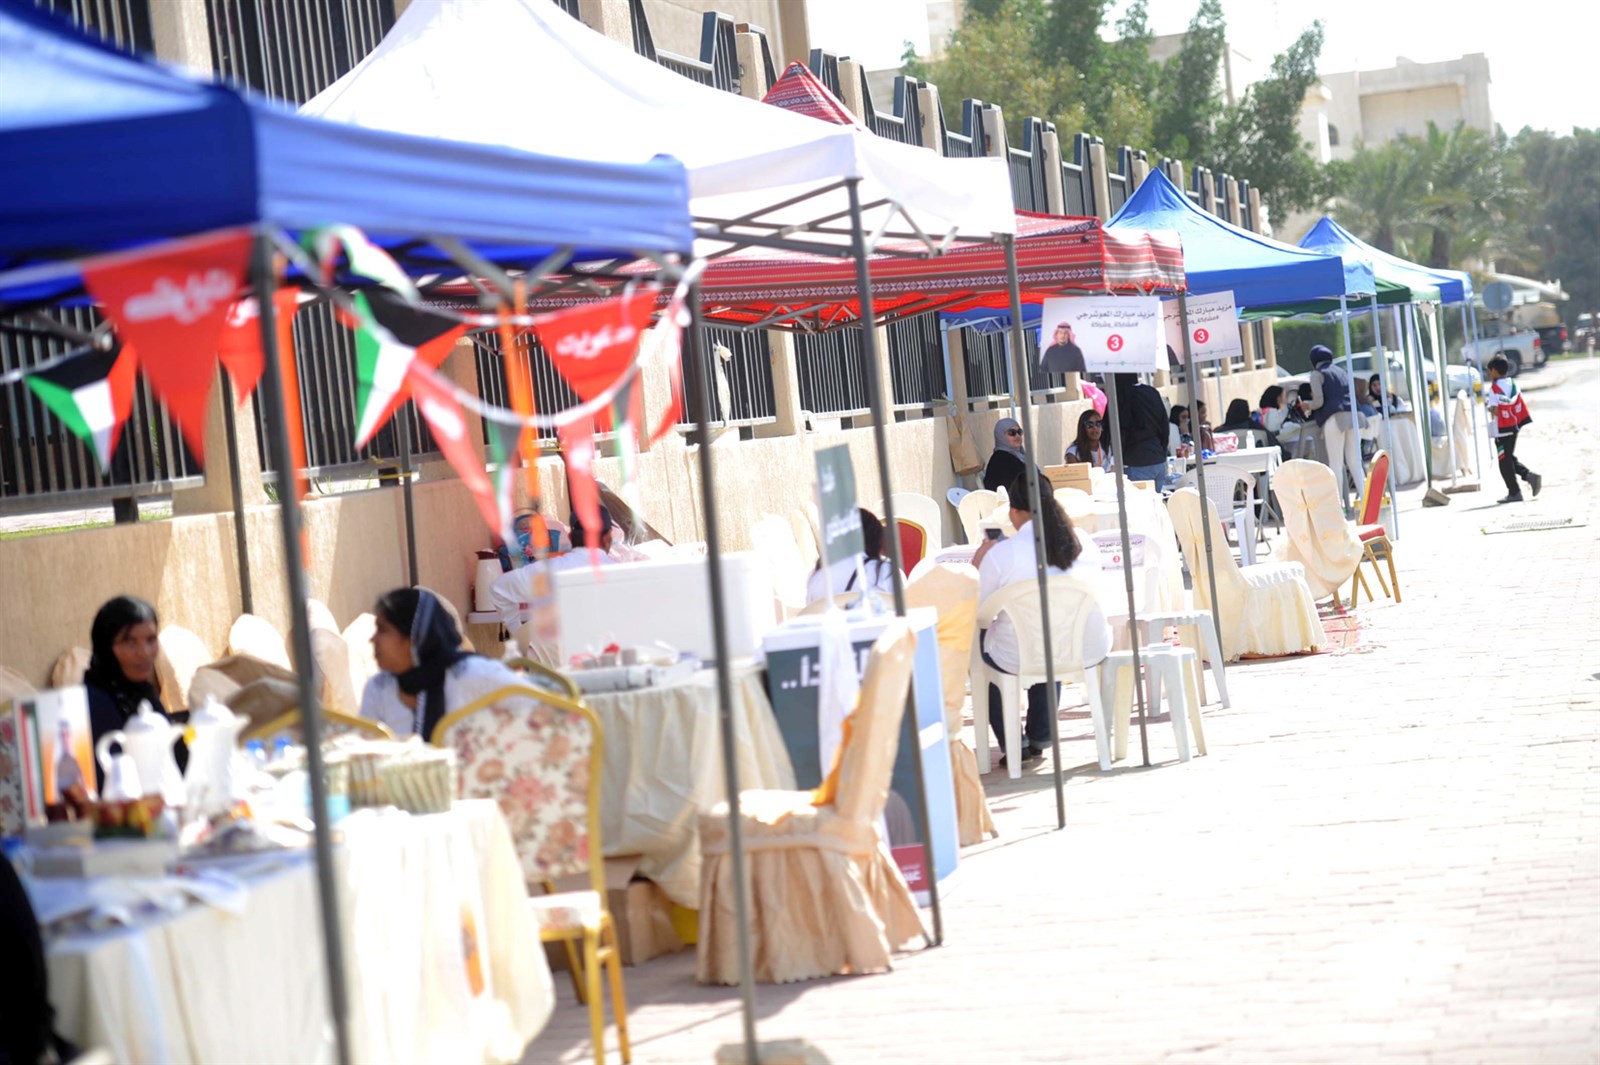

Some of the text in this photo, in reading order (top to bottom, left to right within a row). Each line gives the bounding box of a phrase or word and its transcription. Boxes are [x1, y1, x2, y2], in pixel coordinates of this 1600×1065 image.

[1195, 307, 1215, 315] مبارك
[1216, 304, 1232, 312] مزيد
[1113, 310, 1135, 319] مبارك
[1137, 310, 1155, 320] مزيد
[1197, 330, 1206, 341] 3
[1110, 336, 1120, 349] 3
